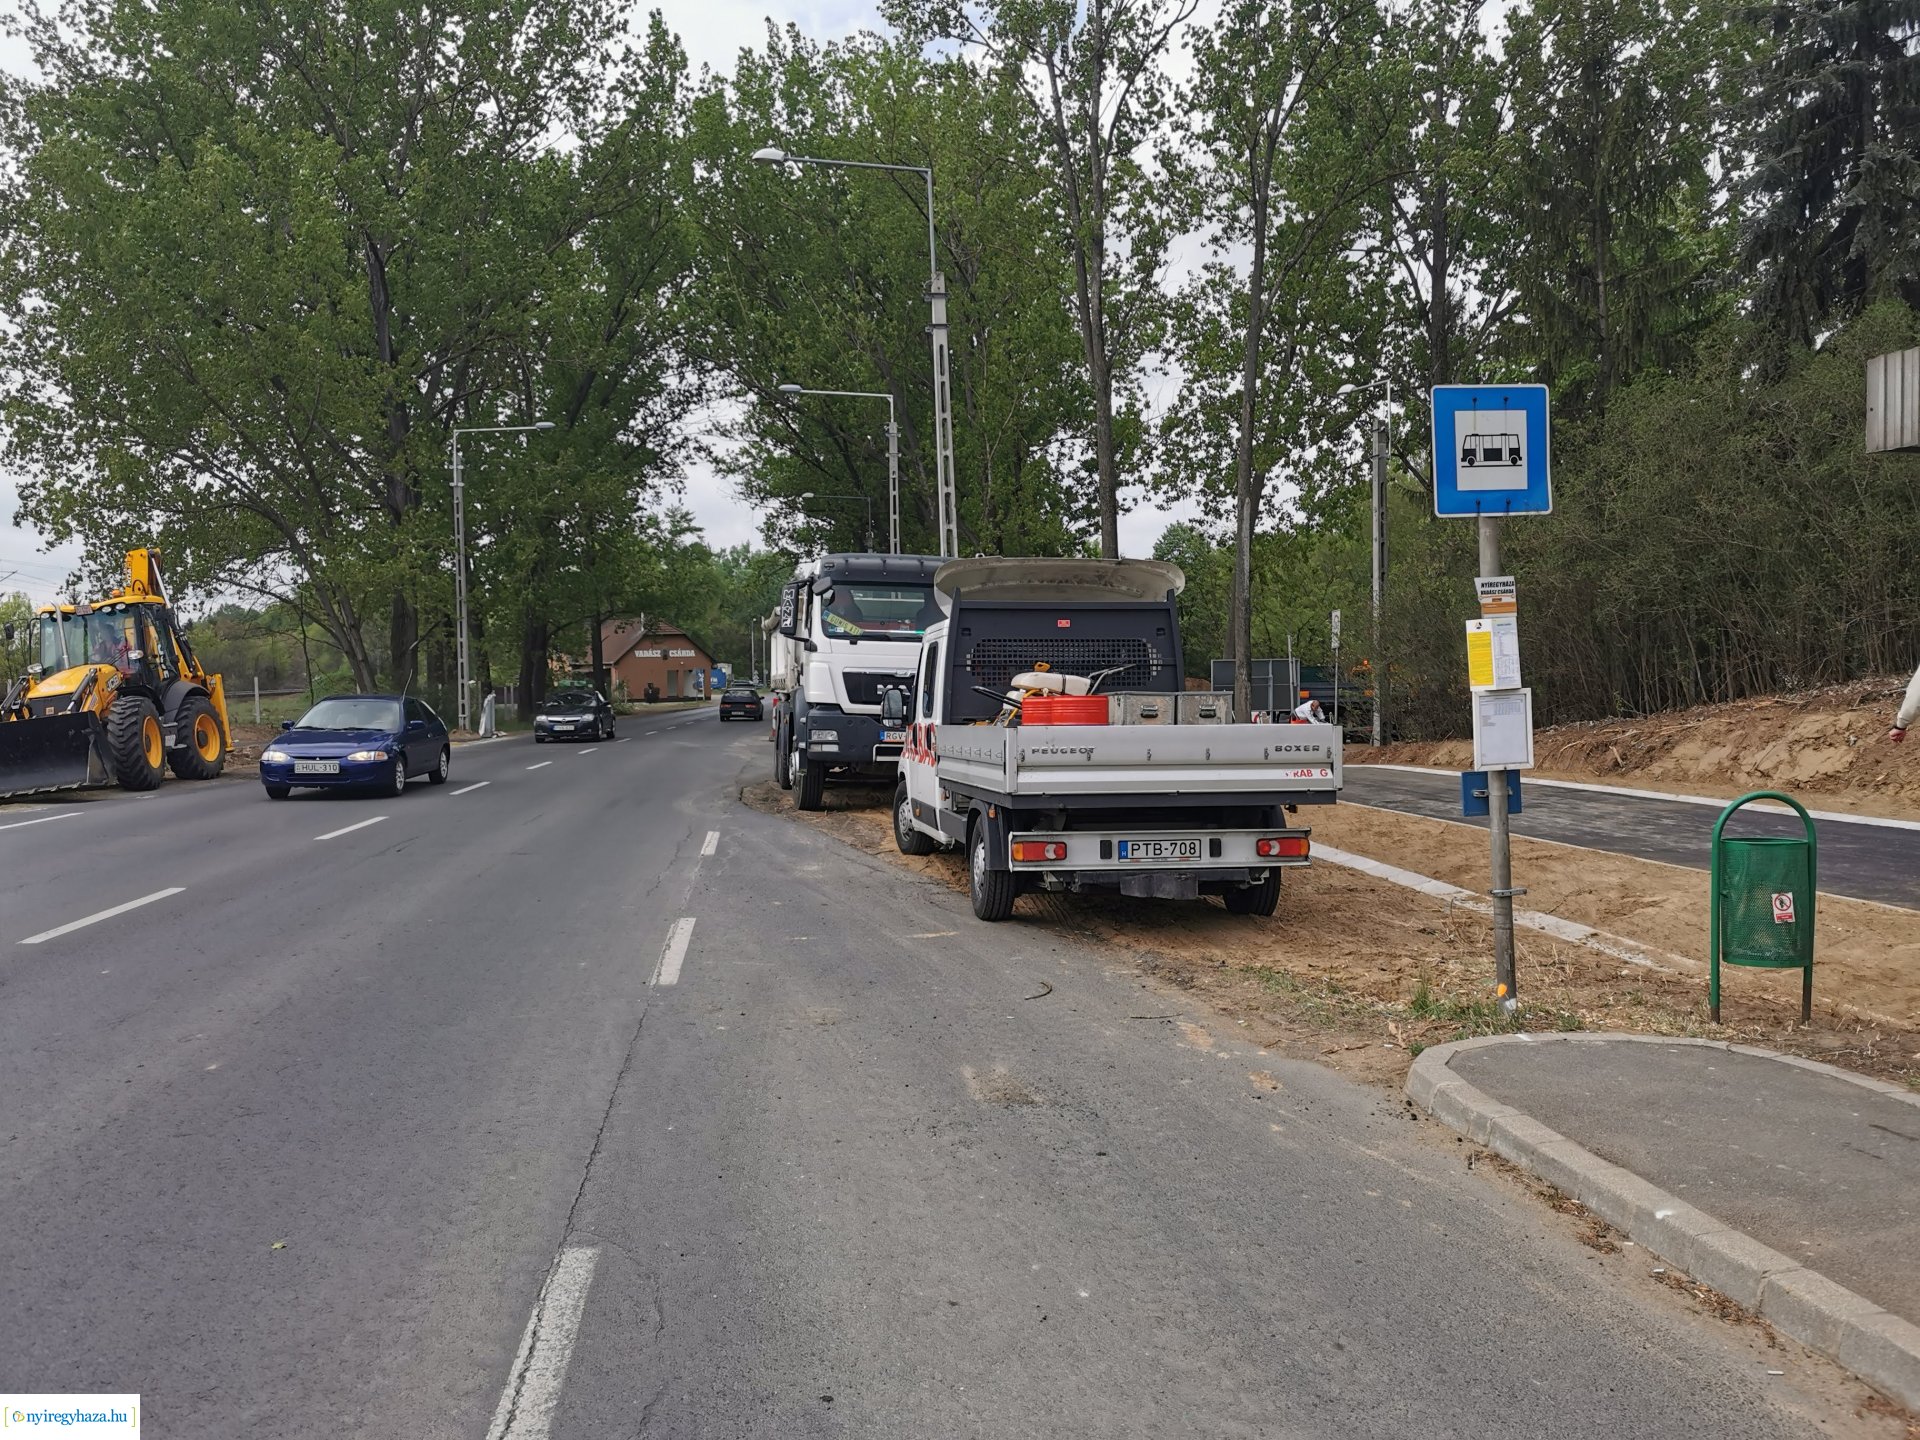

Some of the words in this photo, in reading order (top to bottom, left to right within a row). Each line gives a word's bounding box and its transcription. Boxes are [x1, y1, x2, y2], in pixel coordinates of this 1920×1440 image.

[782, 589, 795, 618] MAN
[107, 674, 119, 691] JCB
[877, 684, 911, 695] MA
[886, 732, 906, 740] RGV-
[1031, 746, 1096, 755] PEUGEOT
[302, 763, 338, 772] HUL-310
[1131, 842, 1197, 856] PTB-708
